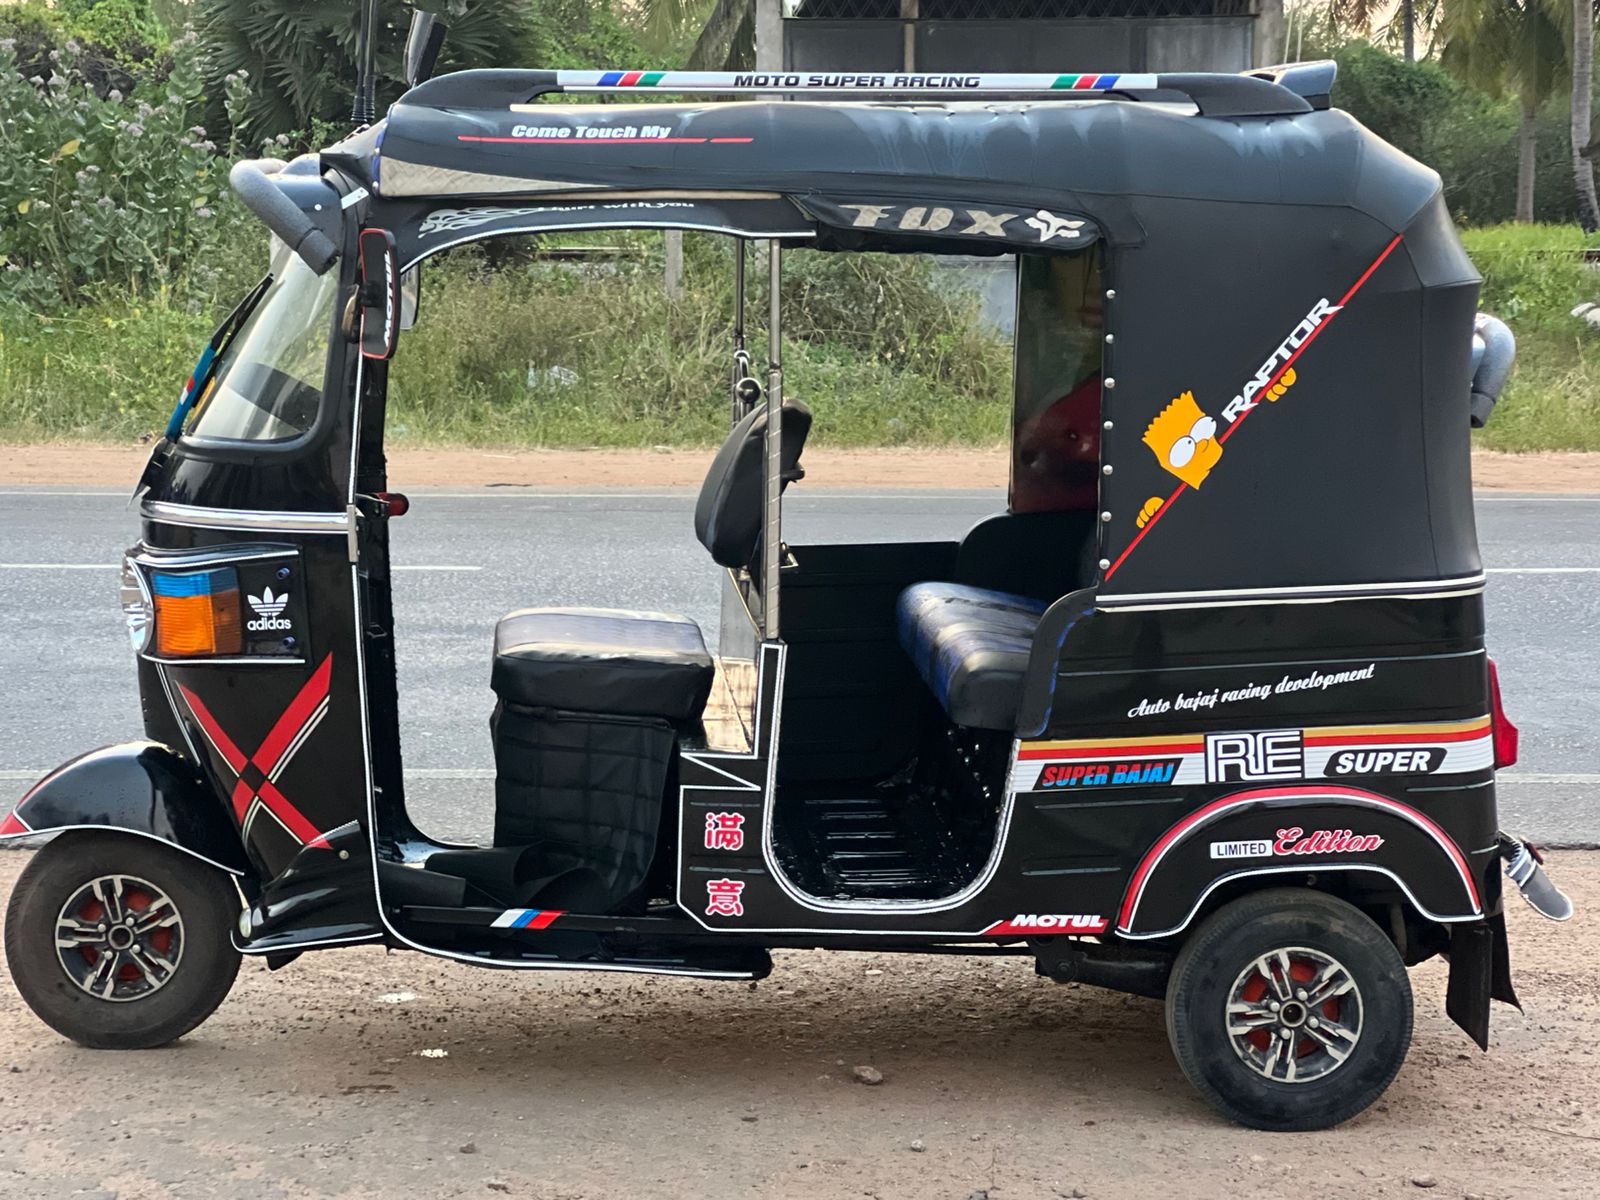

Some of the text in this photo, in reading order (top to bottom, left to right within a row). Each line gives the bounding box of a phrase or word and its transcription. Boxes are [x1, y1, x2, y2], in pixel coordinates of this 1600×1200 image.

[734, 75, 981, 88] MOTO SUPER RACING
[511, 124, 672, 139] Come Touch My
[383, 249, 393, 348] MOTUL
[1221, 297, 1344, 423] RAPTOR
[247, 617, 292, 631] adidas
[1127, 663, 1375, 718] Auto bajaj racing development
[1042, 761, 1175, 787] SUPER BAJAJ
[1335, 750, 1432, 775] SUPER
[1217, 826, 1385, 856] LIMITED Edition
[1009, 913, 1105, 928] MOTUL
